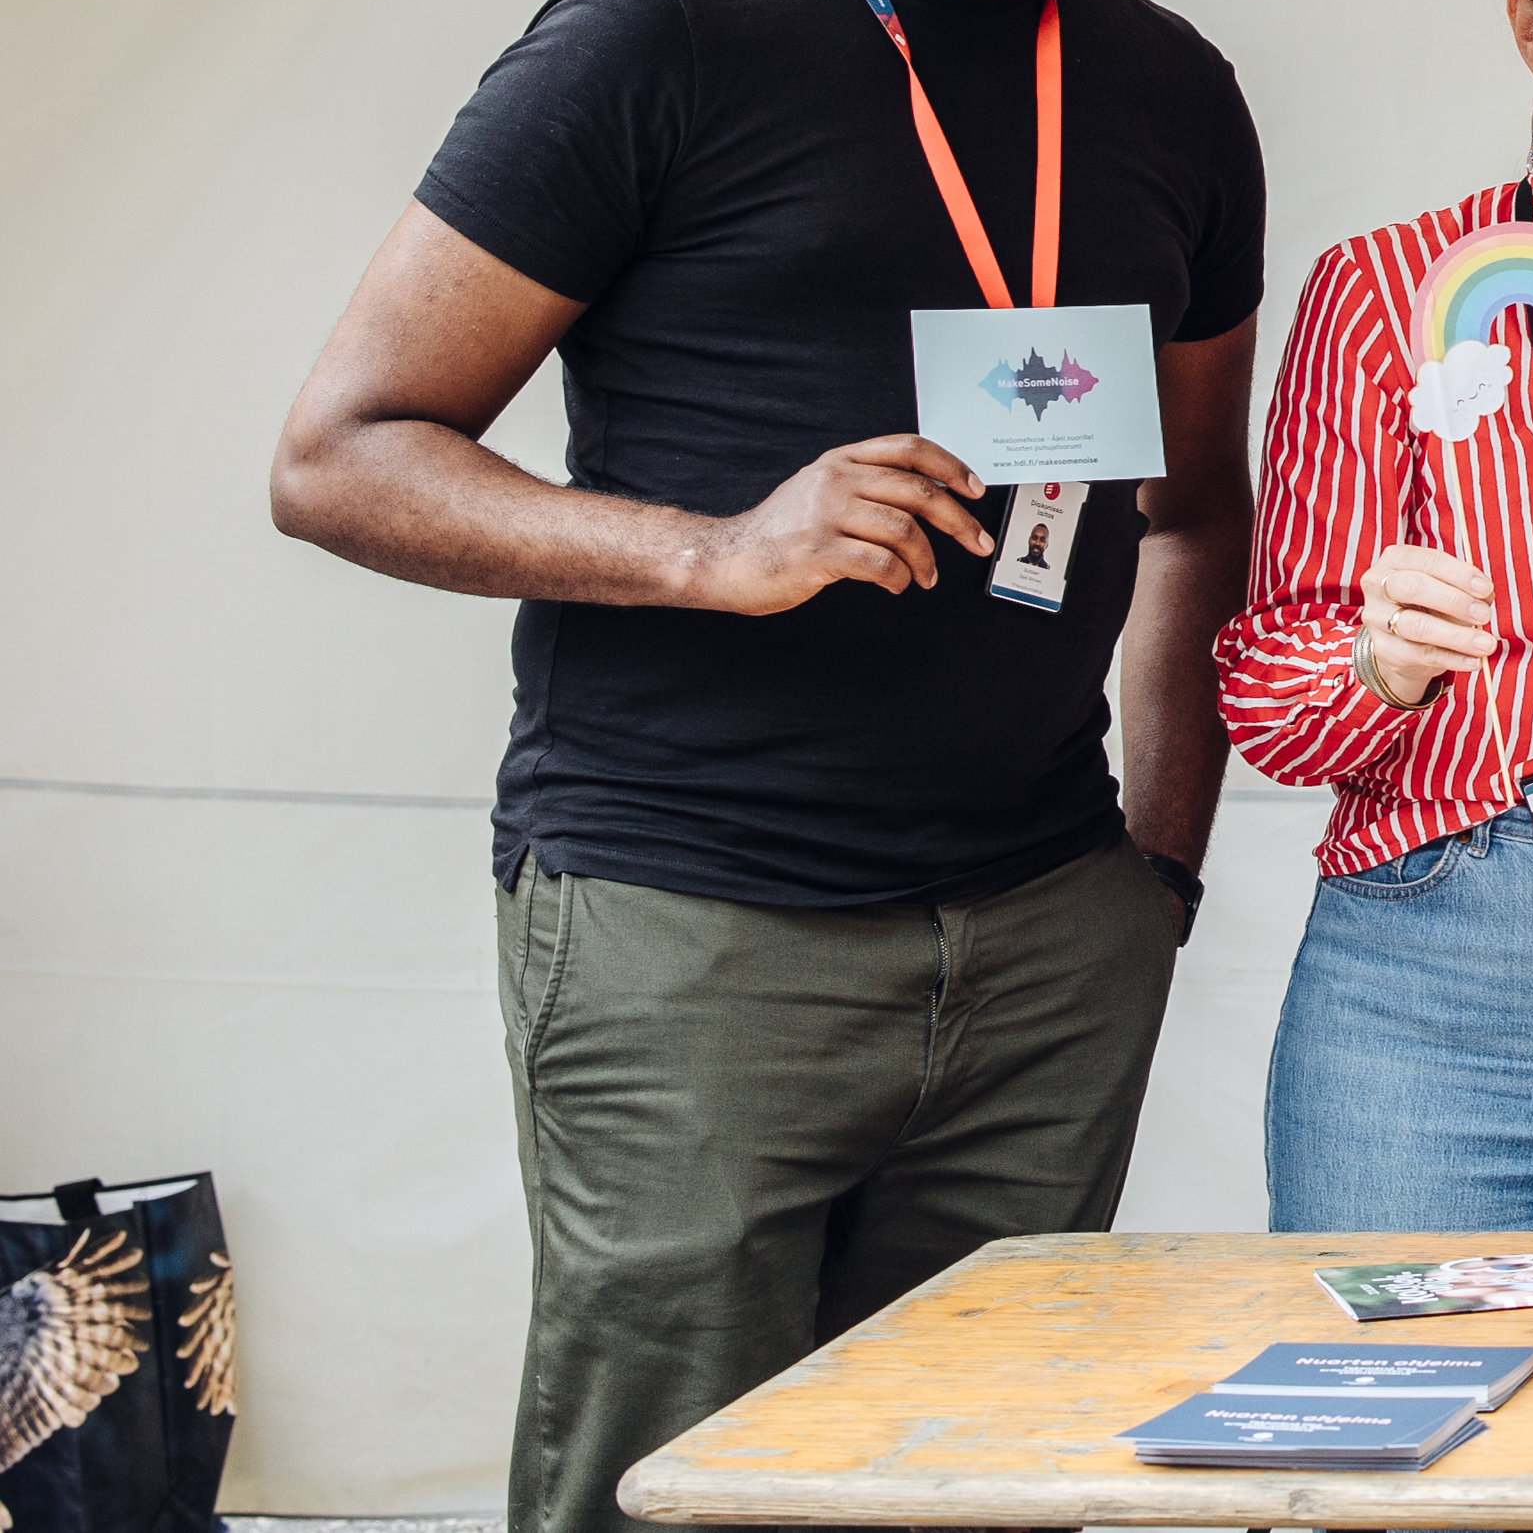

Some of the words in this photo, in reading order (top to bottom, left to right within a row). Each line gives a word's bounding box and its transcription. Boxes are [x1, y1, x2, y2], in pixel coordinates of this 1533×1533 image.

[997, 376, 1080, 389] MakeSomeNoise
[1295, 1357, 1388, 1366] Nuorten
[1205, 1410, 1298, 1421] Nuorten
